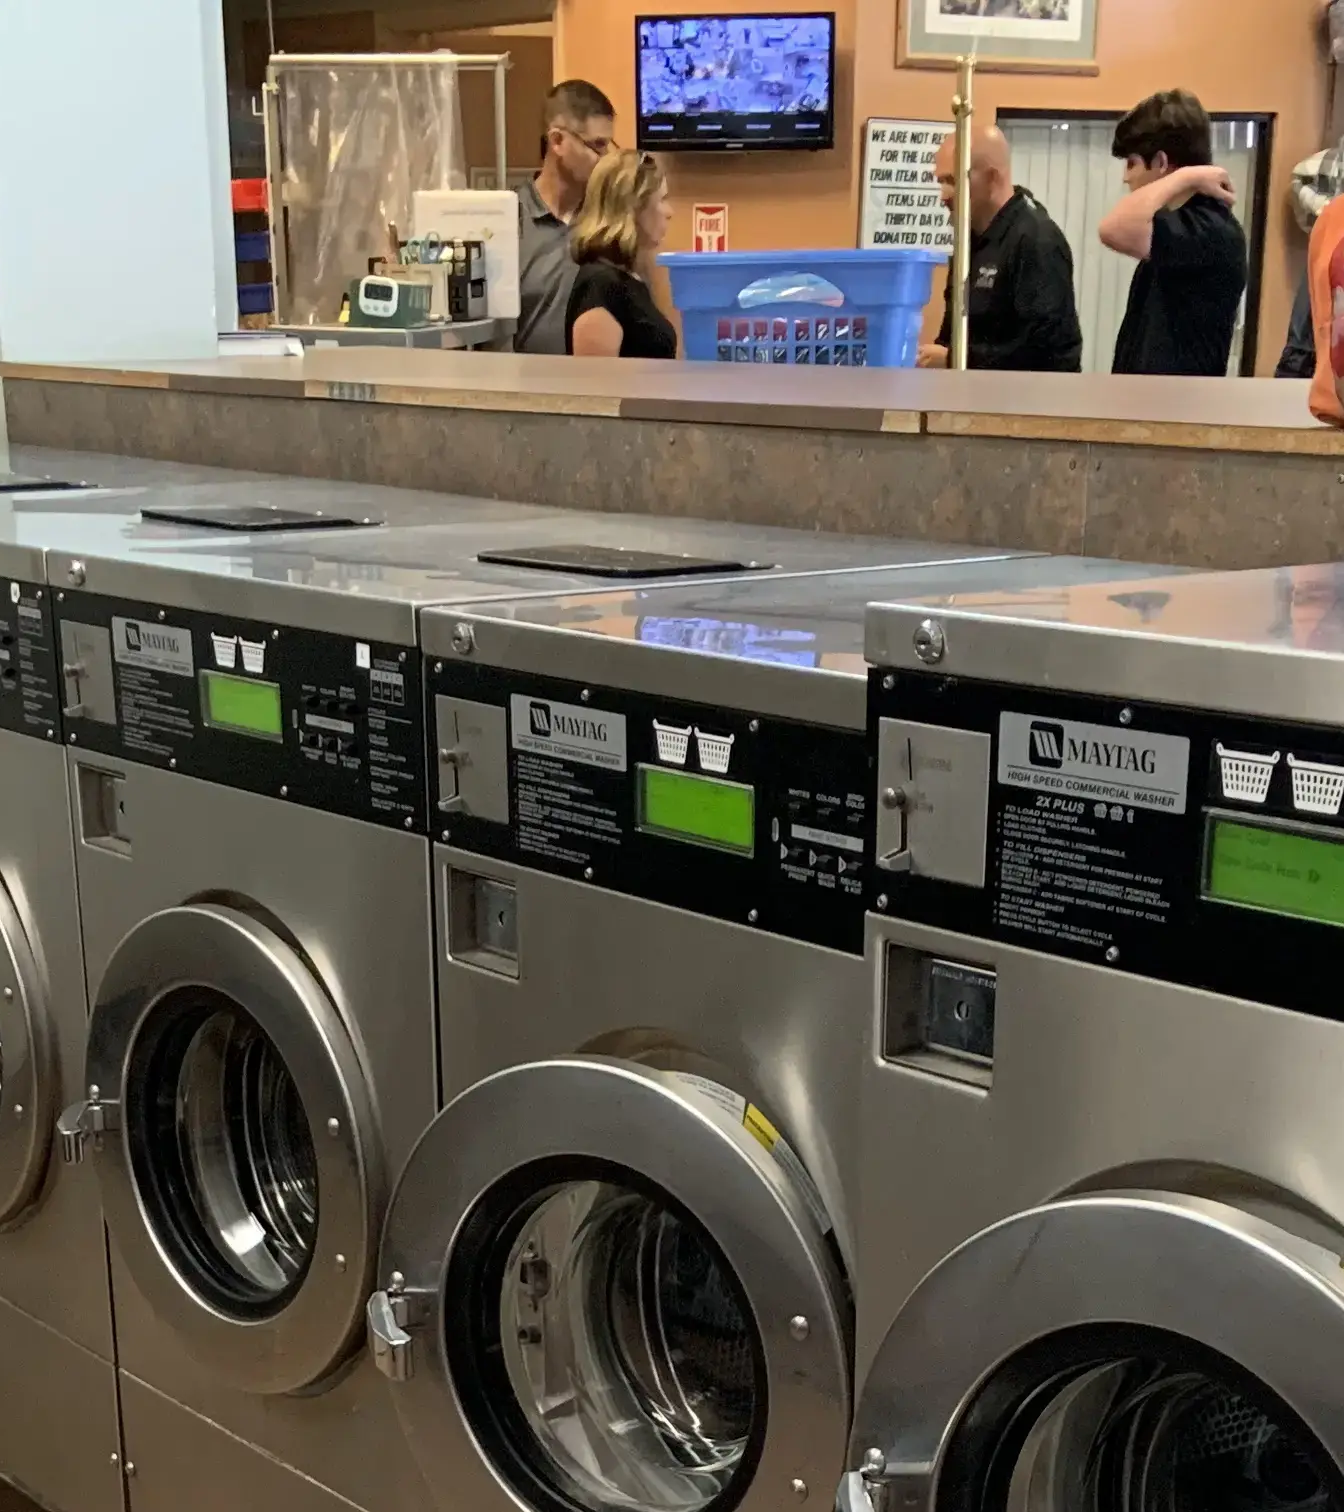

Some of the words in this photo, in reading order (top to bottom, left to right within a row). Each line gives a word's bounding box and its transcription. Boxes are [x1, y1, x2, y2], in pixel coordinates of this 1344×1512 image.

[872, 130, 886, 142] WE
[889, 130, 908, 144] ARE
[910, 132, 928, 144] NOT
[880, 150, 898, 162] FOR
[902, 150, 918, 163] THE
[870, 168, 893, 181] TRIM
[895, 170, 918, 182] ITEM
[886, 194, 914, 206] ITEMS
[917, 195, 938, 207] LEFT
[885, 213, 917, 226] THIRTY
[920, 214, 944, 226] DAYS
[873, 232, 917, 244] DONATED
[920, 232, 932, 244] TO
[554, 715, 607, 742] MAYTAG
[1068, 738, 1156, 774] MAYTAG
[1008, 771, 1030, 782] HIGH
[1033, 775, 1062, 788] SPEED
[1066, 781, 1129, 800] COMMERCIAL
[1134, 792, 1175, 807] WASHER
[1036, 796, 1051, 807] 2X
[1052, 798, 1084, 814] PLUS
[1017, 806, 1040, 816] LOAD
[1042, 810, 1078, 824] WASHER
